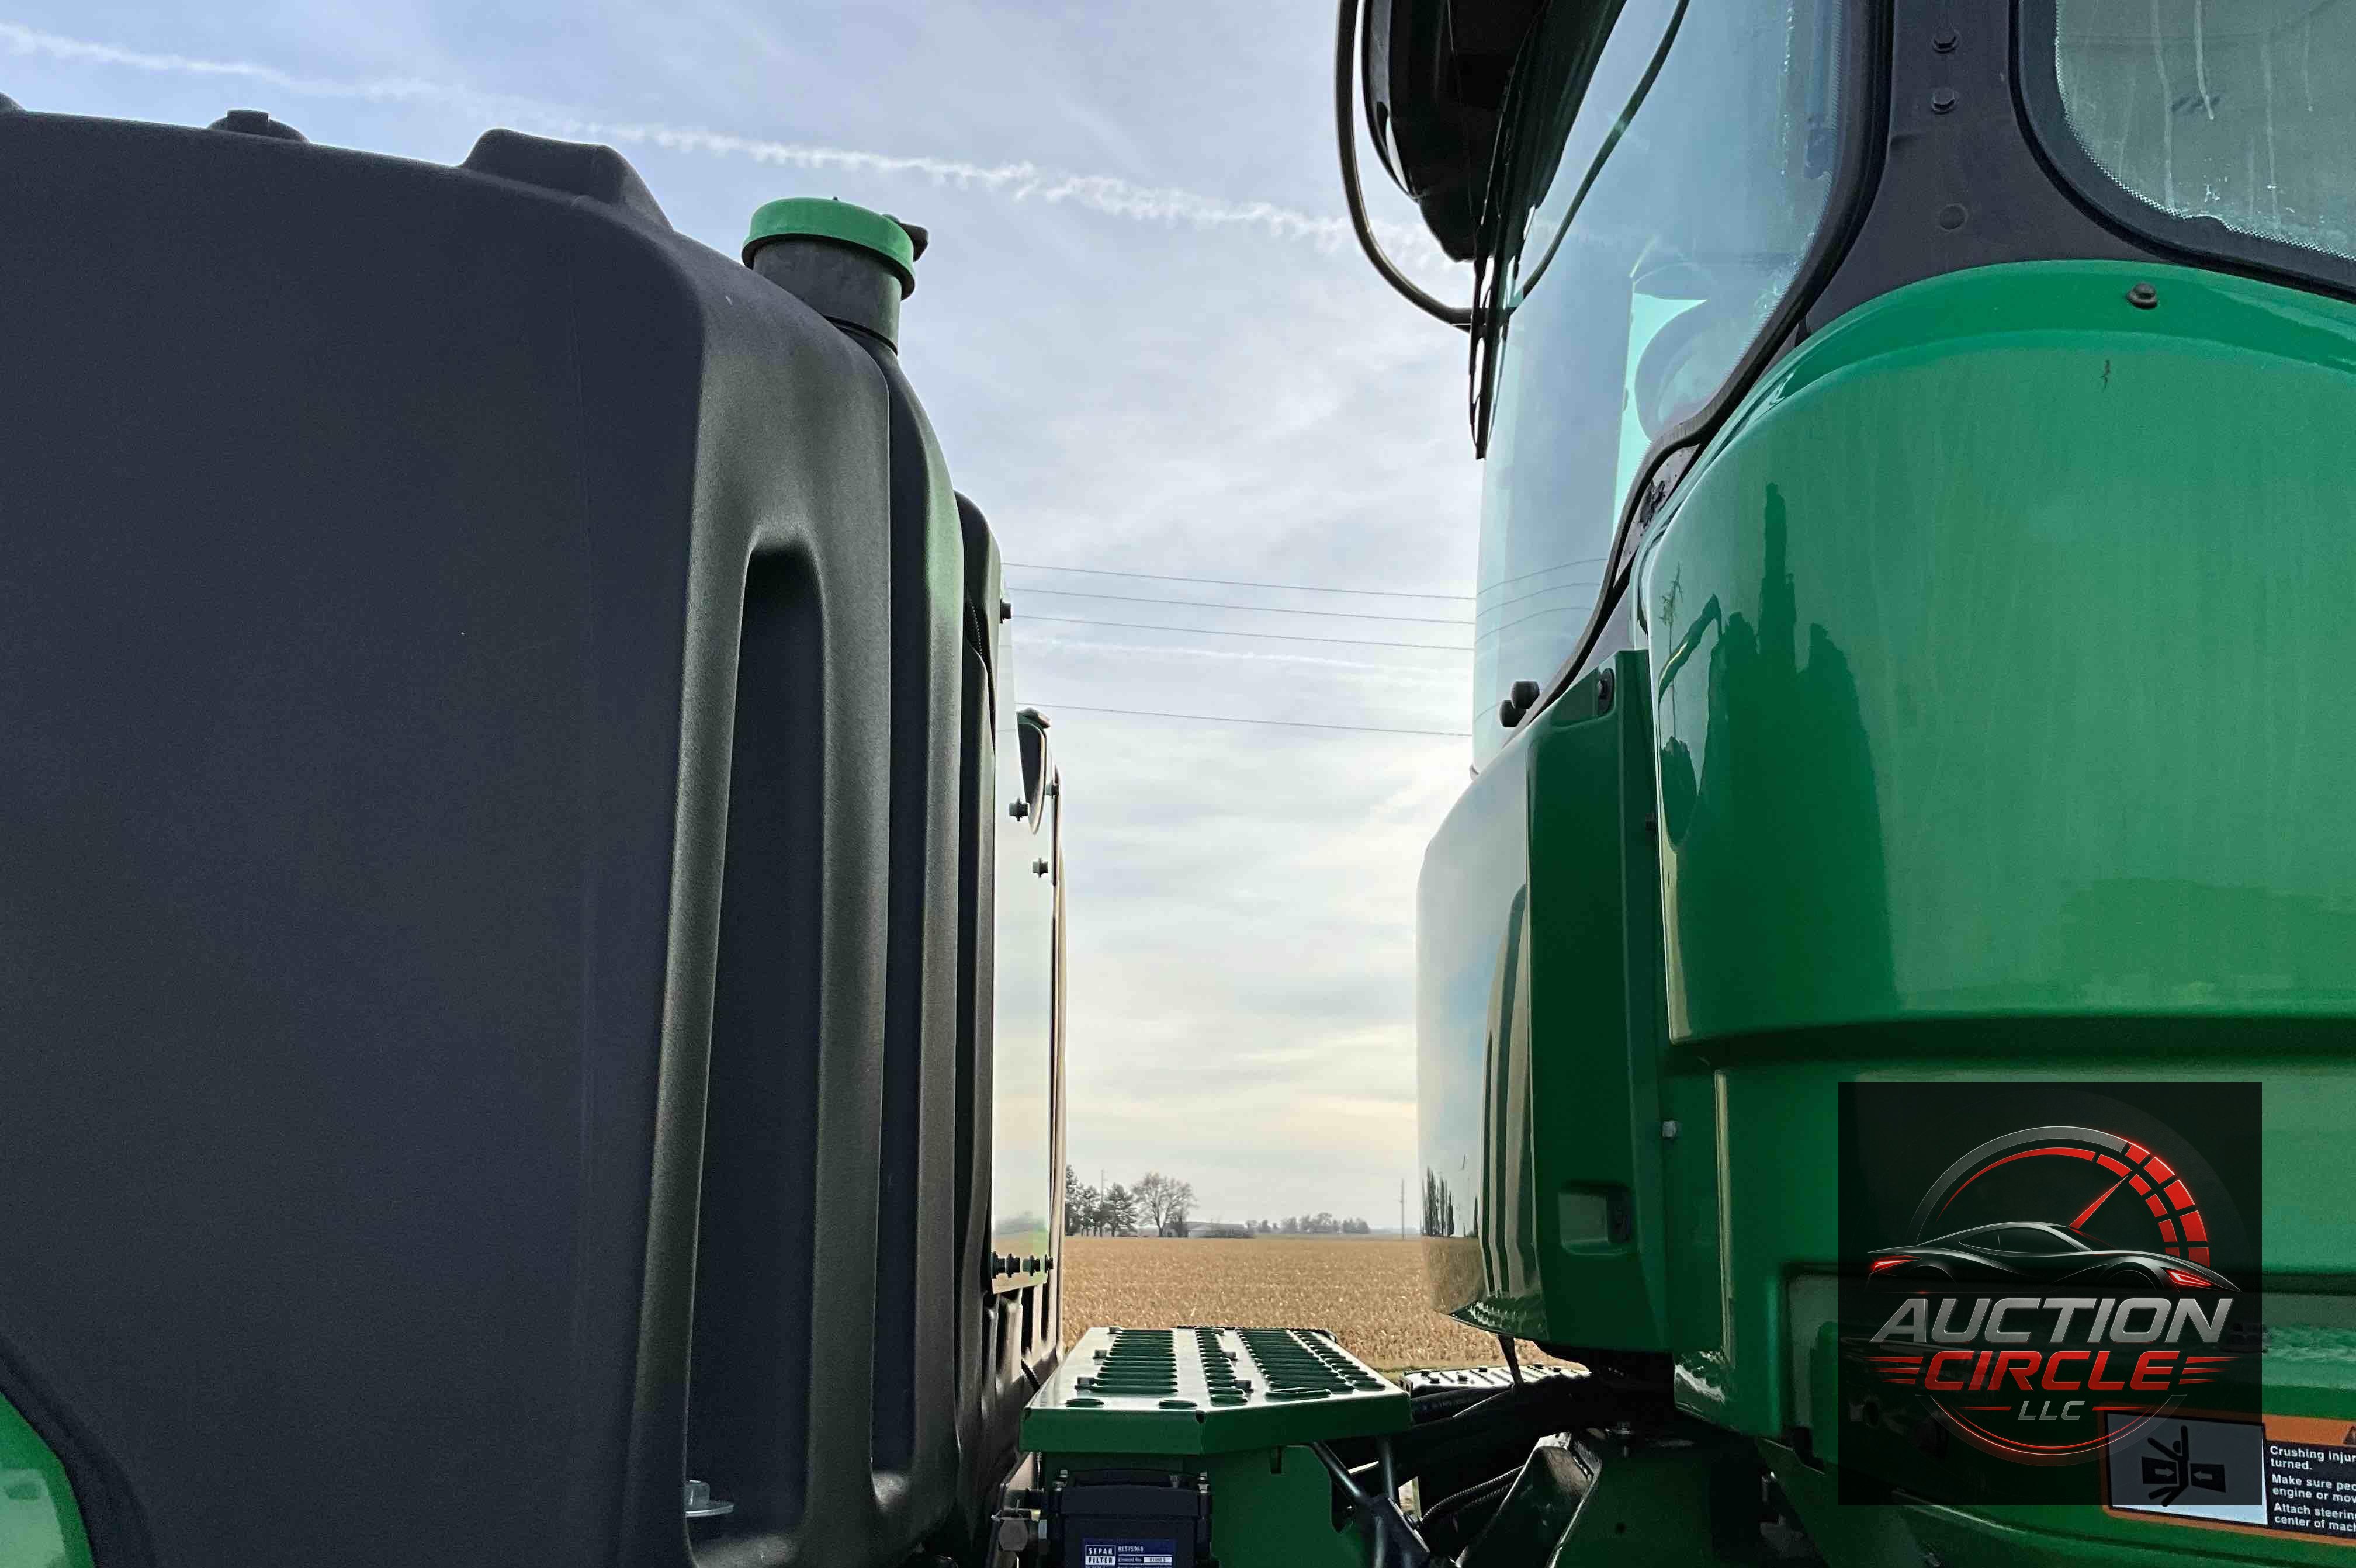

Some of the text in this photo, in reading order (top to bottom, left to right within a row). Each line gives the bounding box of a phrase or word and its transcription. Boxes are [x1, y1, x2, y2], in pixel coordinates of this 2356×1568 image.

[2270, 1445, 2324, 1462] Crushing
[2271, 1458, 2313, 1470] turned.
[2272, 1473, 2302, 1486] Make
[2306, 1479, 2333, 1489] sure
[2272, 1487, 2312, 1498] engine
[2316, 1491, 2329, 1500] or
[2274, 1502, 2356, 1520] Attach steerin
[2274, 1515, 2311, 1527] center
[2314, 1519, 2326, 1529] of
